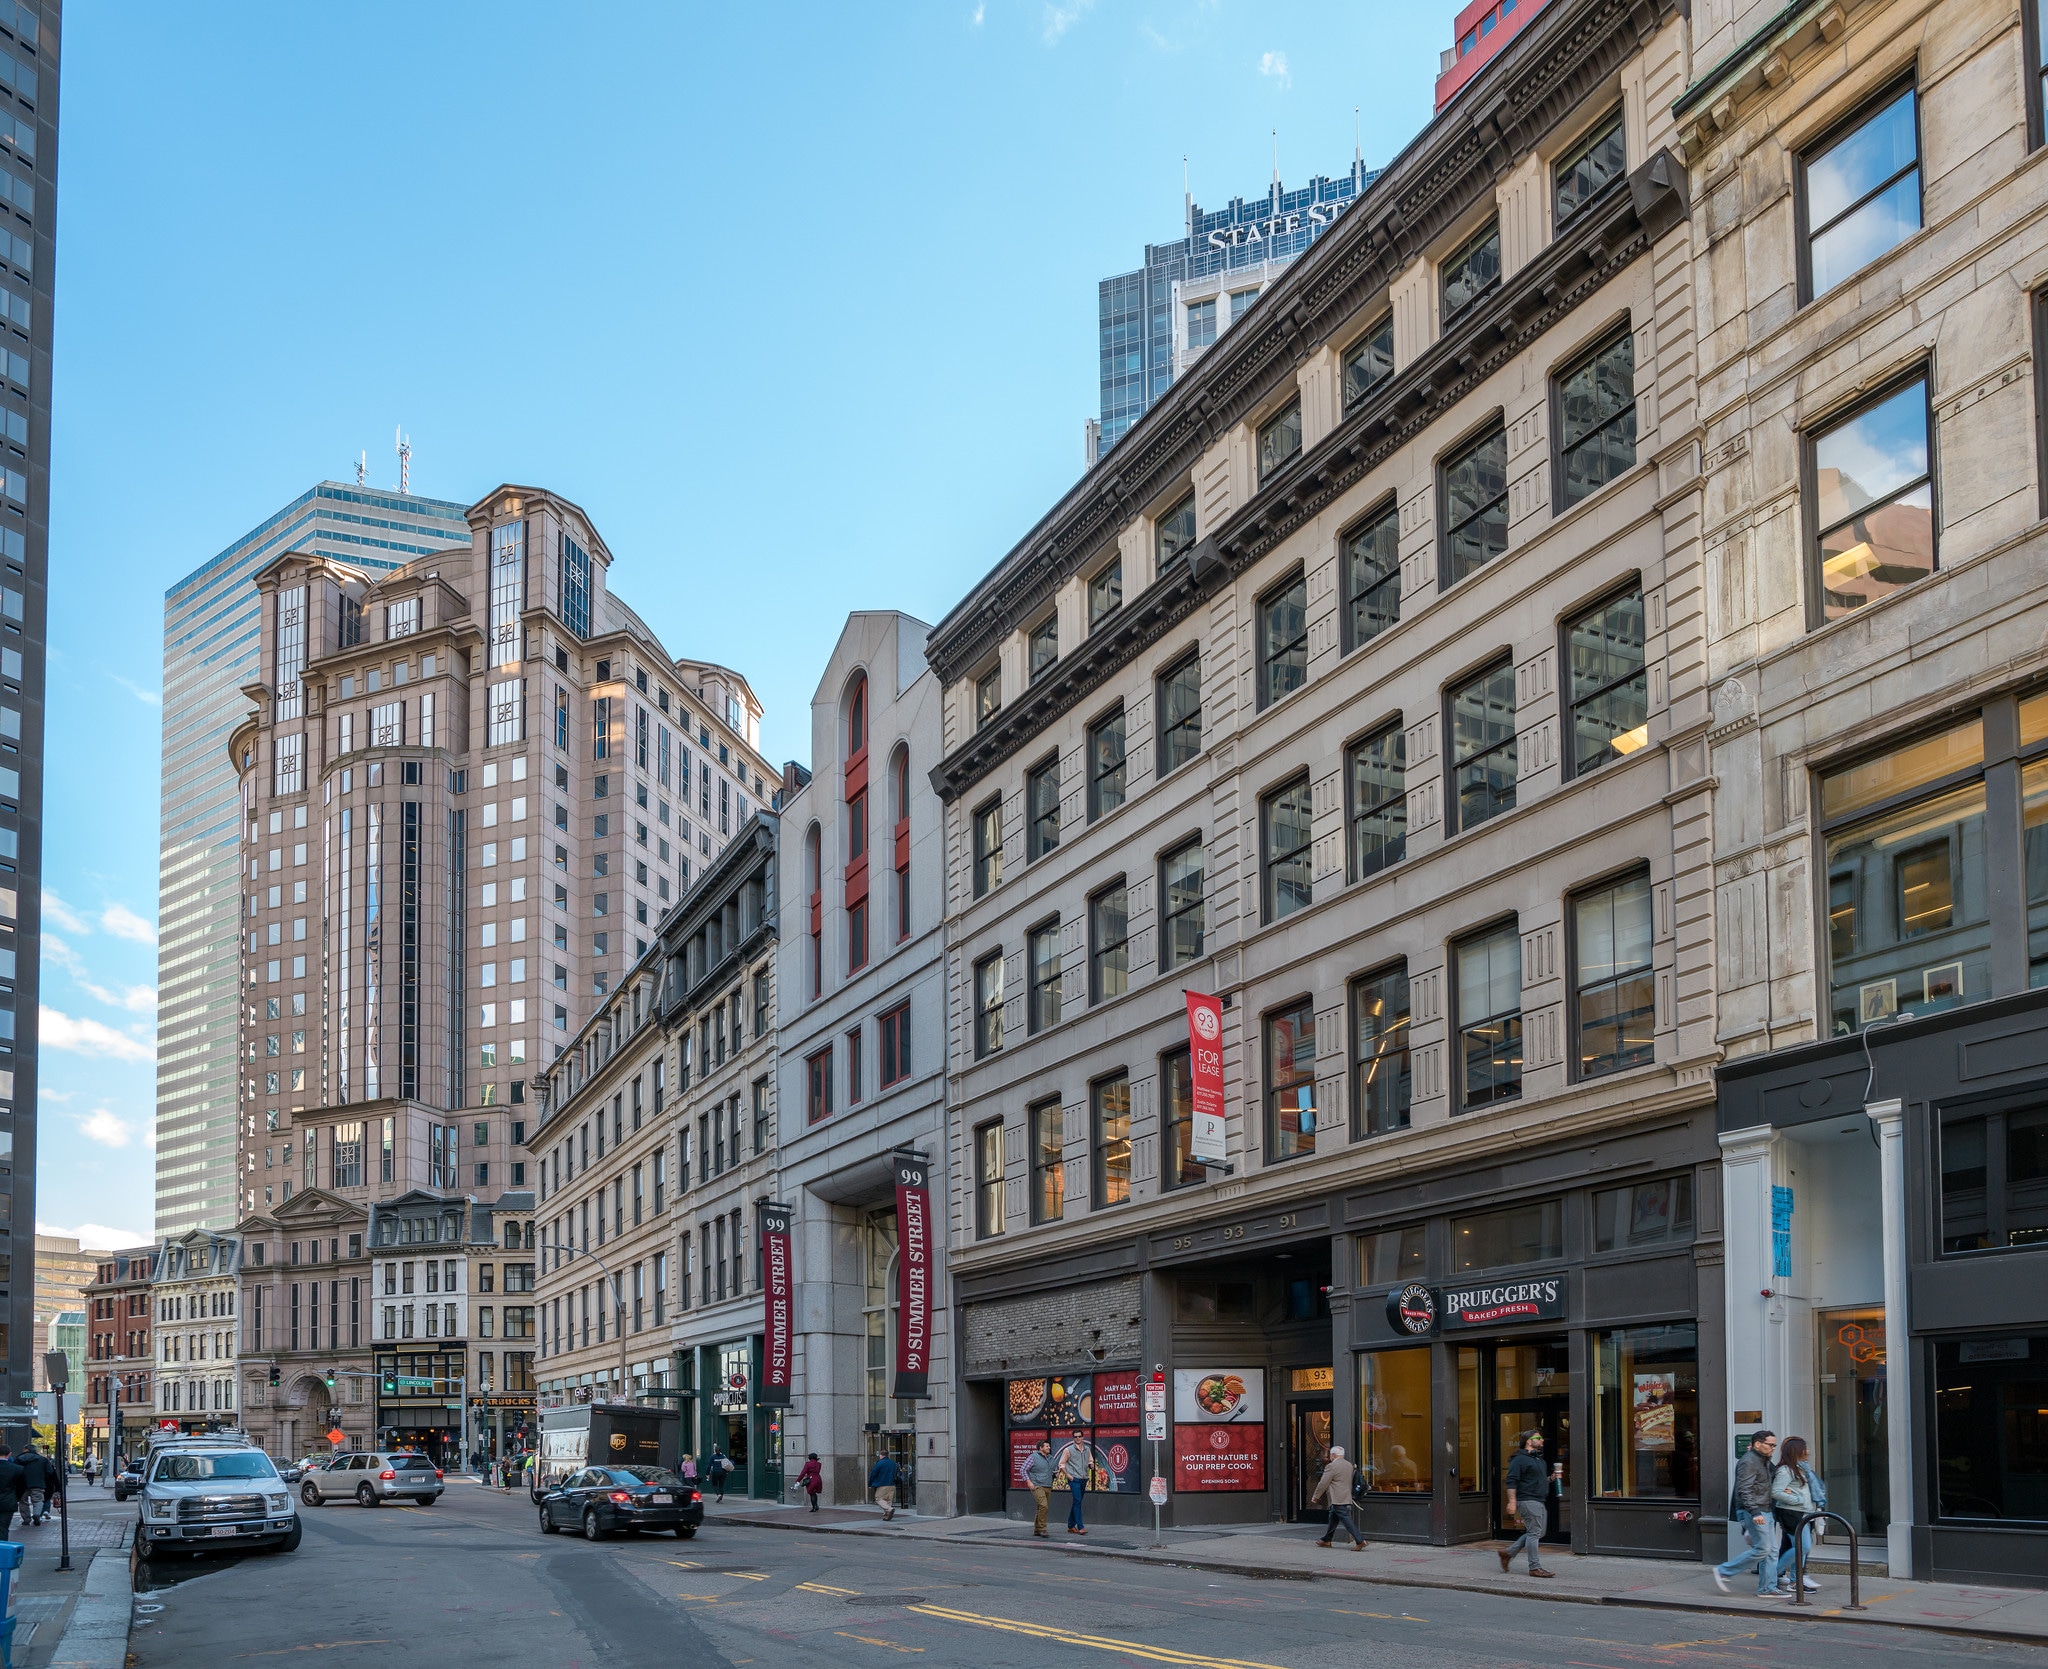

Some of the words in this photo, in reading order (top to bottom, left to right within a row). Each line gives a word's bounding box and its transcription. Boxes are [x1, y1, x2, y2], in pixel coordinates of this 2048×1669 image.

[1208, 214, 1300, 249] STATE
[1308, 200, 1353, 224] ST
[1198, 1012, 1214, 1029] 93
[1198, 1048, 1219, 1066] FOR
[1198, 1063, 1220, 1078] LEASE
[902, 1169, 922, 1186] 99
[766, 1218, 785, 1232] 99
[906, 1190, 924, 1263] STREET
[1174, 1236, 1192, 1250] 95
[1224, 1226, 1244, 1240] 93
[1280, 1214, 1296, 1228] 91
[770, 1236, 786, 1296] STREET
[908, 1266, 924, 1350] SUMMER
[1468, 1310, 1498, 1320] BAKED
[1500, 1304, 1529, 1315] FRESH
[1404, 1316, 1430, 1332] BAGELS
[772, 1298, 787, 1368] SUMMER
[1848, 1331, 1854, 1340] 8
[907, 1354, 922, 1370] 99
[772, 1370, 784, 1384] 99
[1314, 1370, 1326, 1380] 93
[575, 1387, 587, 1396] GNC
[714, 1392, 742, 1406] SUPERCUTS
[612, 1439, 625, 1448] ups
